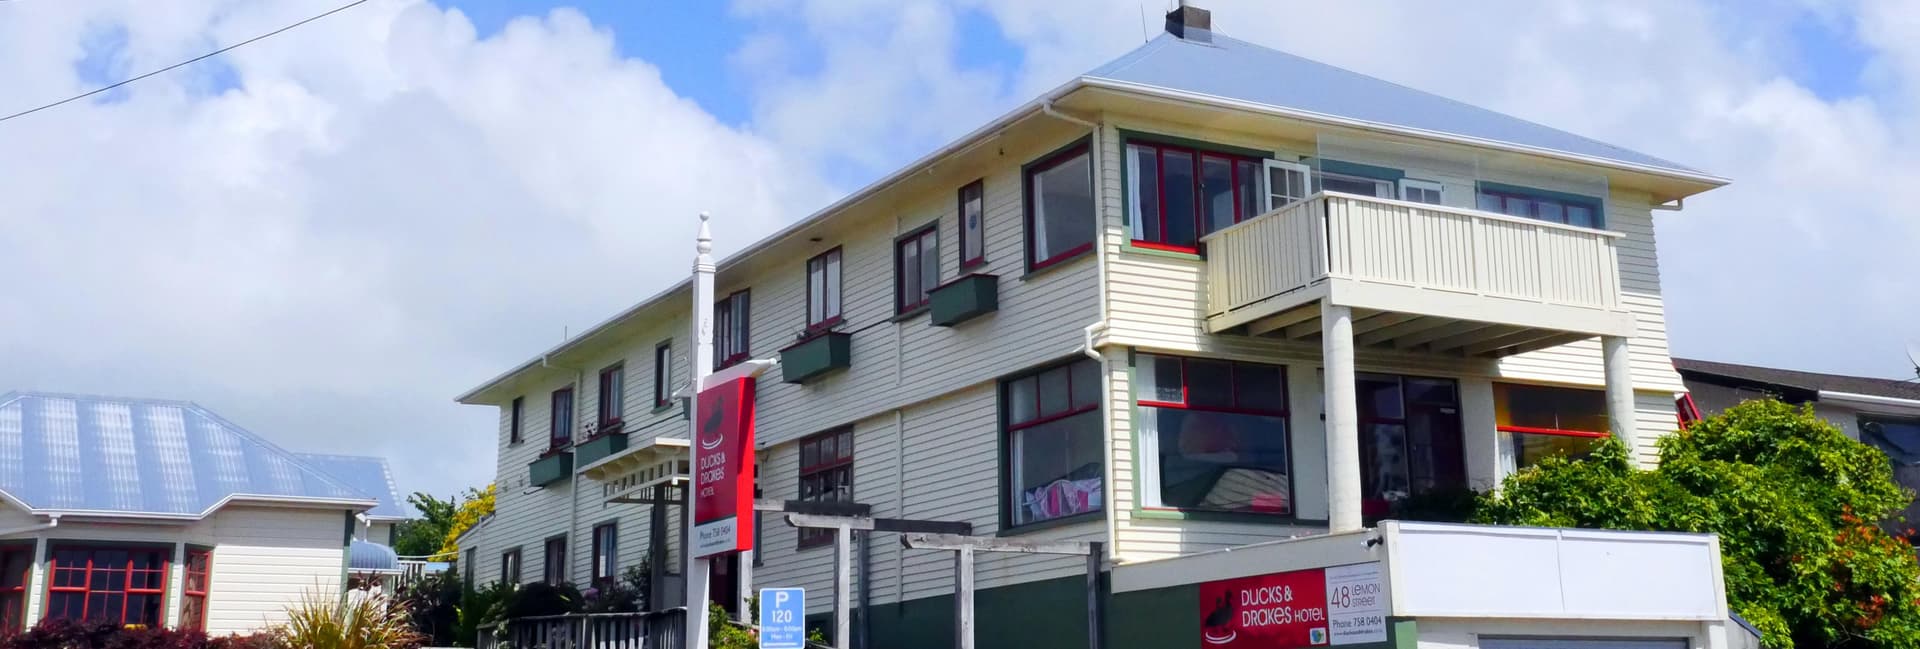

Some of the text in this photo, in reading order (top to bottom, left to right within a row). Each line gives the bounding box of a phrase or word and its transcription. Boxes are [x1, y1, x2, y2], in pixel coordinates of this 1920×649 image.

[775, 591, 789, 609] P
[1284, 585, 1293, 602] &
[1331, 586, 1350, 609] 48
[772, 609, 792, 623] 120
[1353, 616, 1365, 627] 758
[1366, 615, 1382, 626] 0404
